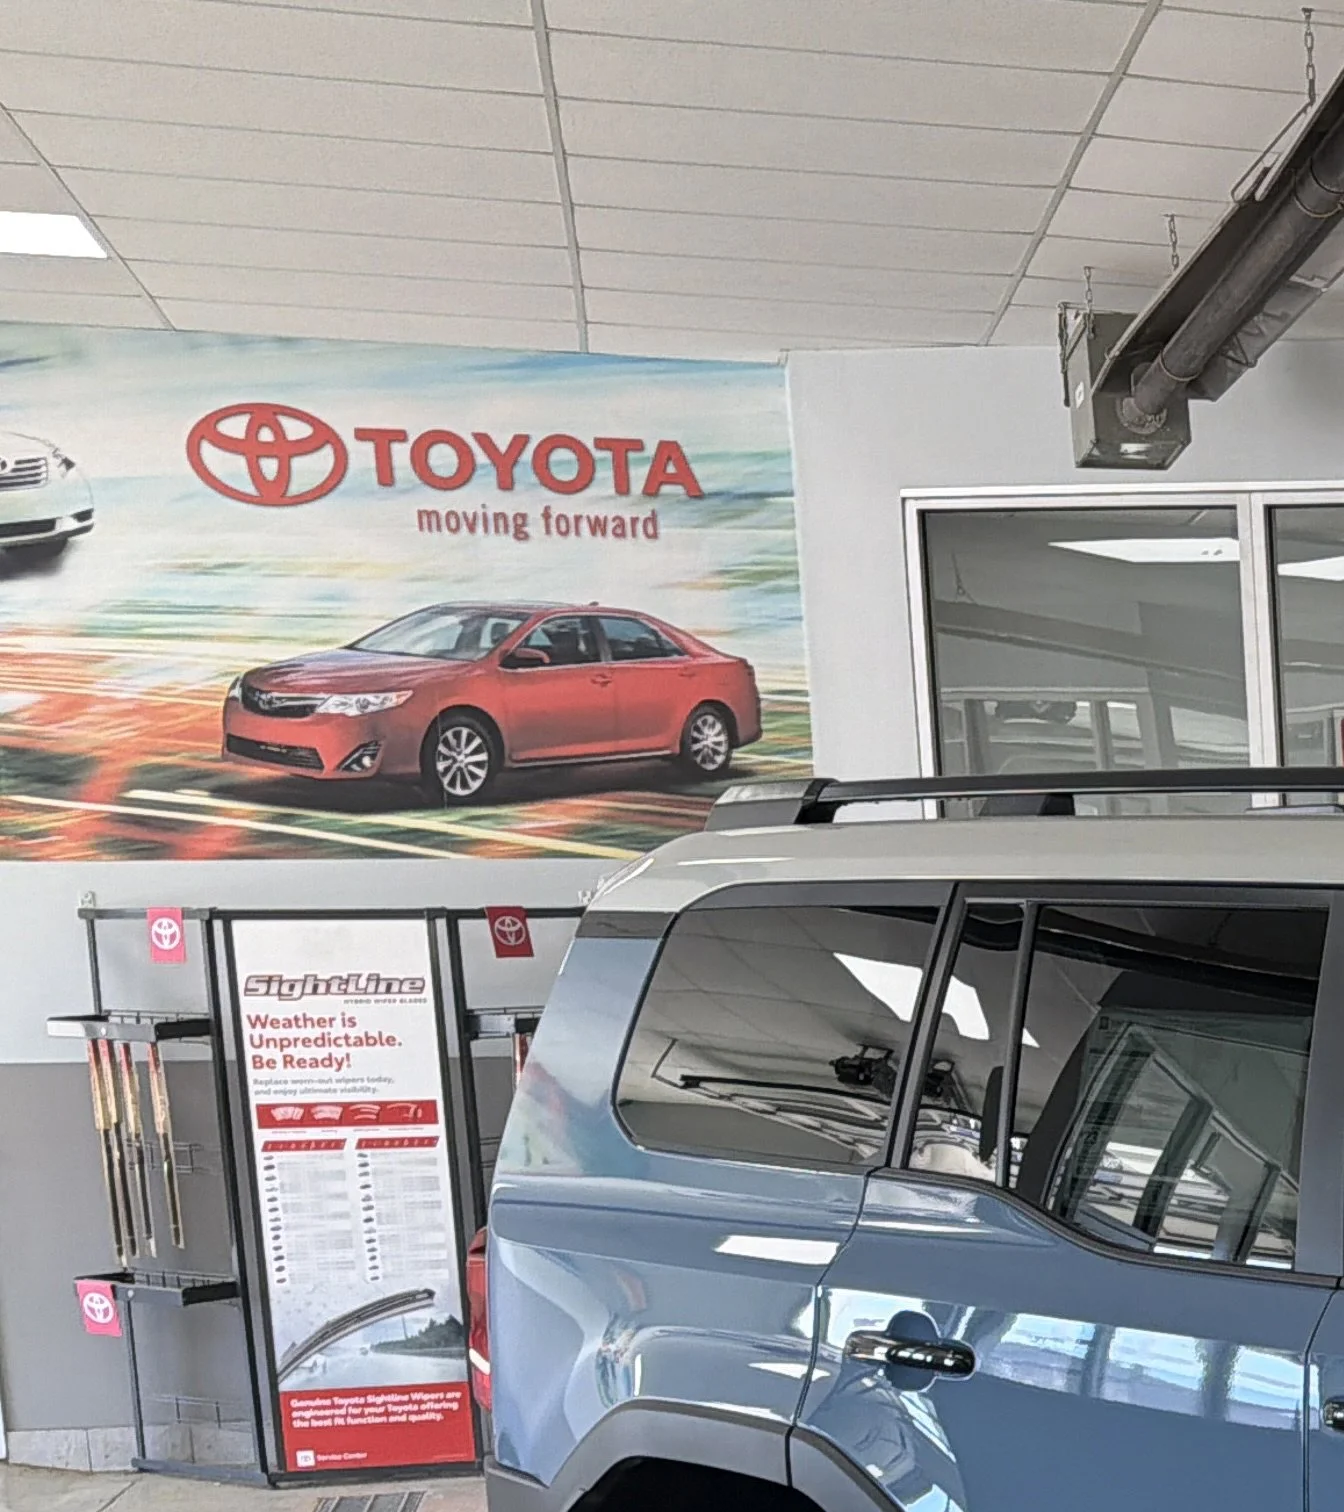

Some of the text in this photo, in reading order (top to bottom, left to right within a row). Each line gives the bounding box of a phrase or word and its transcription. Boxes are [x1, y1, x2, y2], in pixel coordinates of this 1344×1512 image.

[354, 427, 704, 498] TOYOTA
[417, 503, 659, 541] moving forward
[246, 1012, 357, 1030] Weather is
[249, 1031, 403, 1052] Unpredictable.
[252, 1052, 352, 1073] Be Ready!
[253, 1077, 289, 1086] Replace
[335, 1076, 365, 1086] wipers
[254, 1087, 271, 1096] and
[273, 1087, 297, 1097] enjoy
[299, 1086, 338, 1095] ultimate
[333, 1396, 366, 1406] Toyota
[445, 1391, 462, 1399] are
[363, 1405, 386, 1416] your
[386, 1403, 419, 1414] Toyota
[292, 1419, 309, 1428] the
[389, 1414, 407, 1422] and
